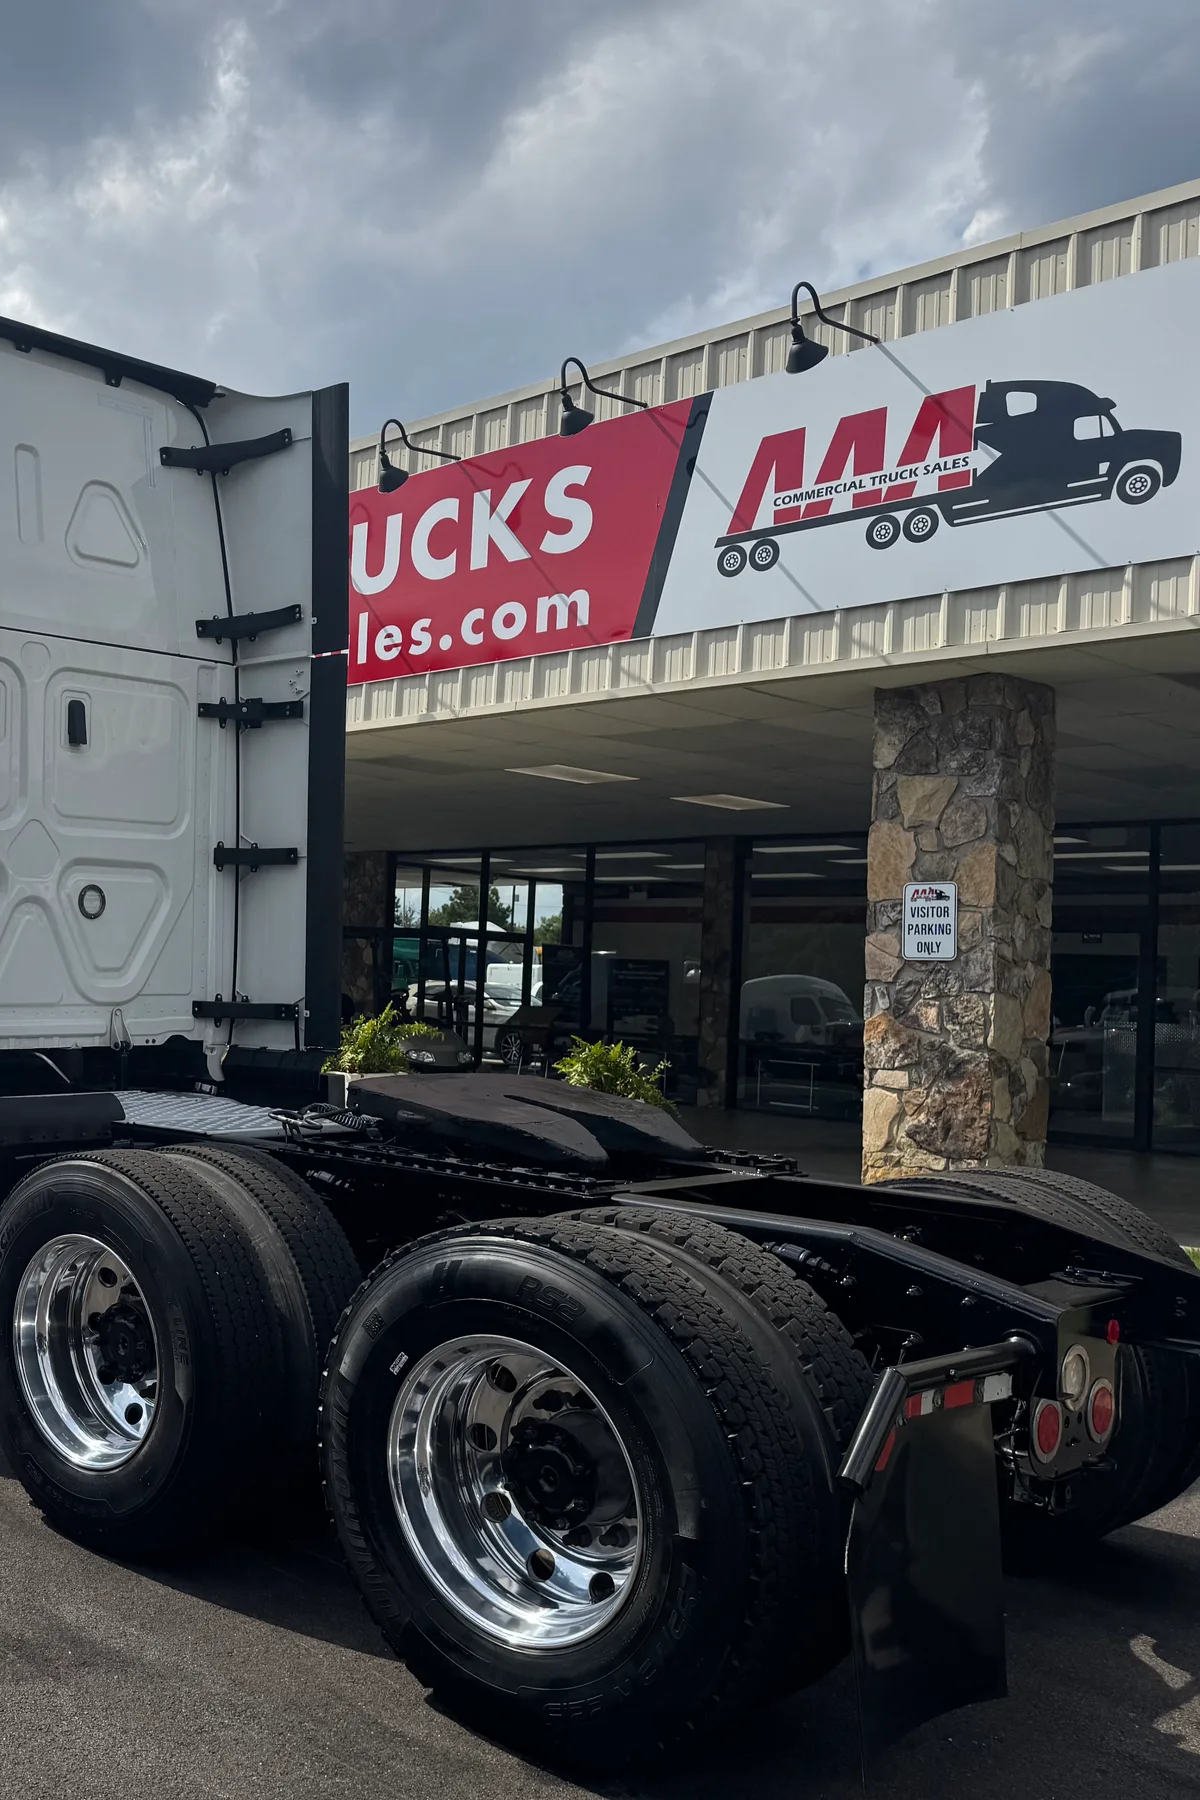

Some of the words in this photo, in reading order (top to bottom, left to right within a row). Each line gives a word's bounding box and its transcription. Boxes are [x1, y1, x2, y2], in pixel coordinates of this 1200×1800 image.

[773, 478, 866, 507] COMMERCIAL
[869, 466, 919, 487] TRUCK
[923, 456, 969, 475] SALES
[351, 465, 594, 595] UCKS
[357, 589, 590, 664] les.com
[910, 906, 950, 918] VISITOR
[907, 923, 952, 935] PARKING
[916, 941, 942, 954] ONLY
